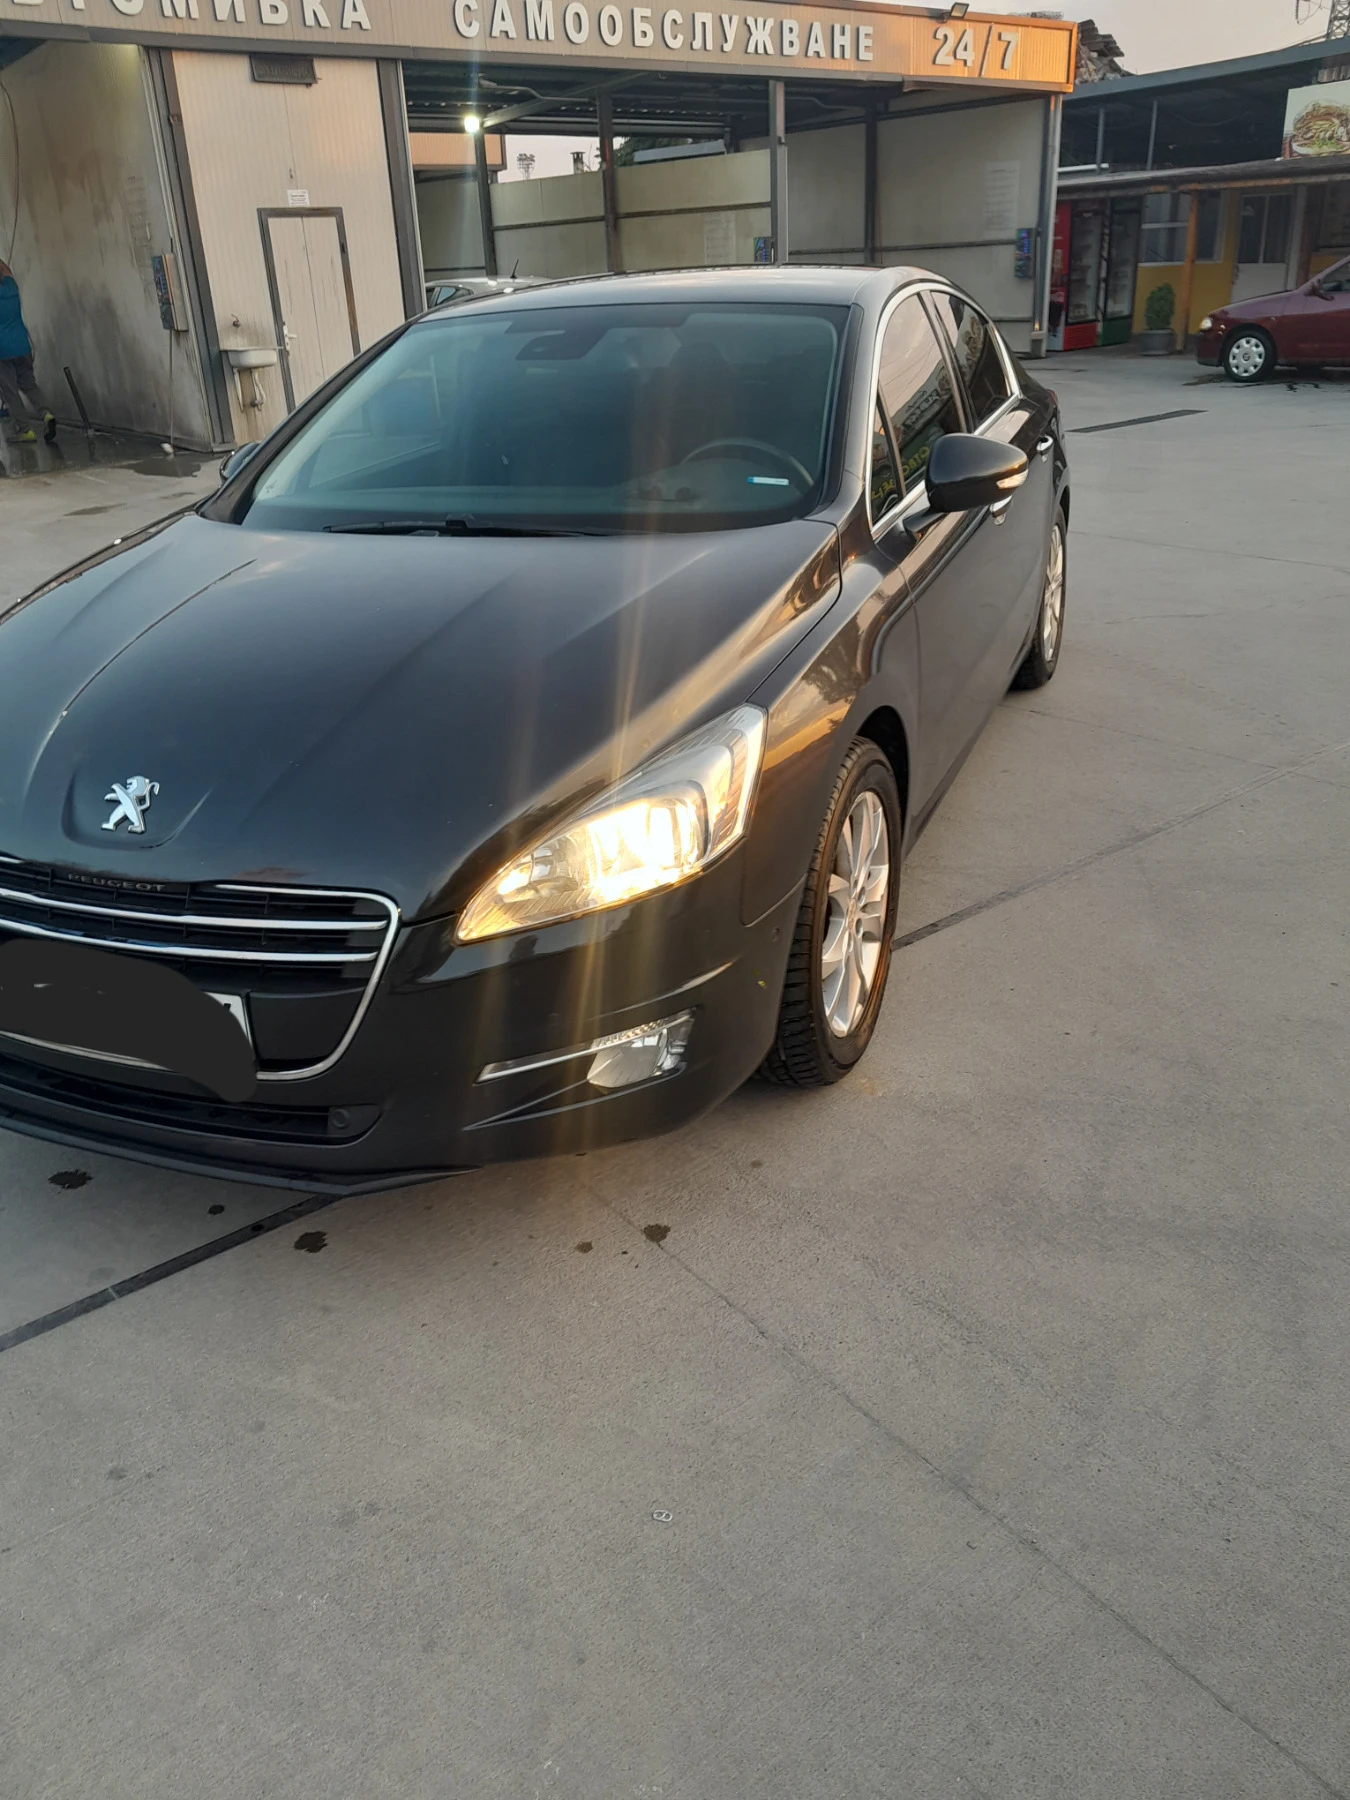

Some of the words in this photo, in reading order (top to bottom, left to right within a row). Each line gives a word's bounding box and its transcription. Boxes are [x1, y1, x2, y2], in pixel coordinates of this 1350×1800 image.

[454, 0, 874, 61] САМООБСЛУЖВАНЕ
[932, 25, 1019, 77] 24/7
[68, 873, 166, 891] PEUGEOT
